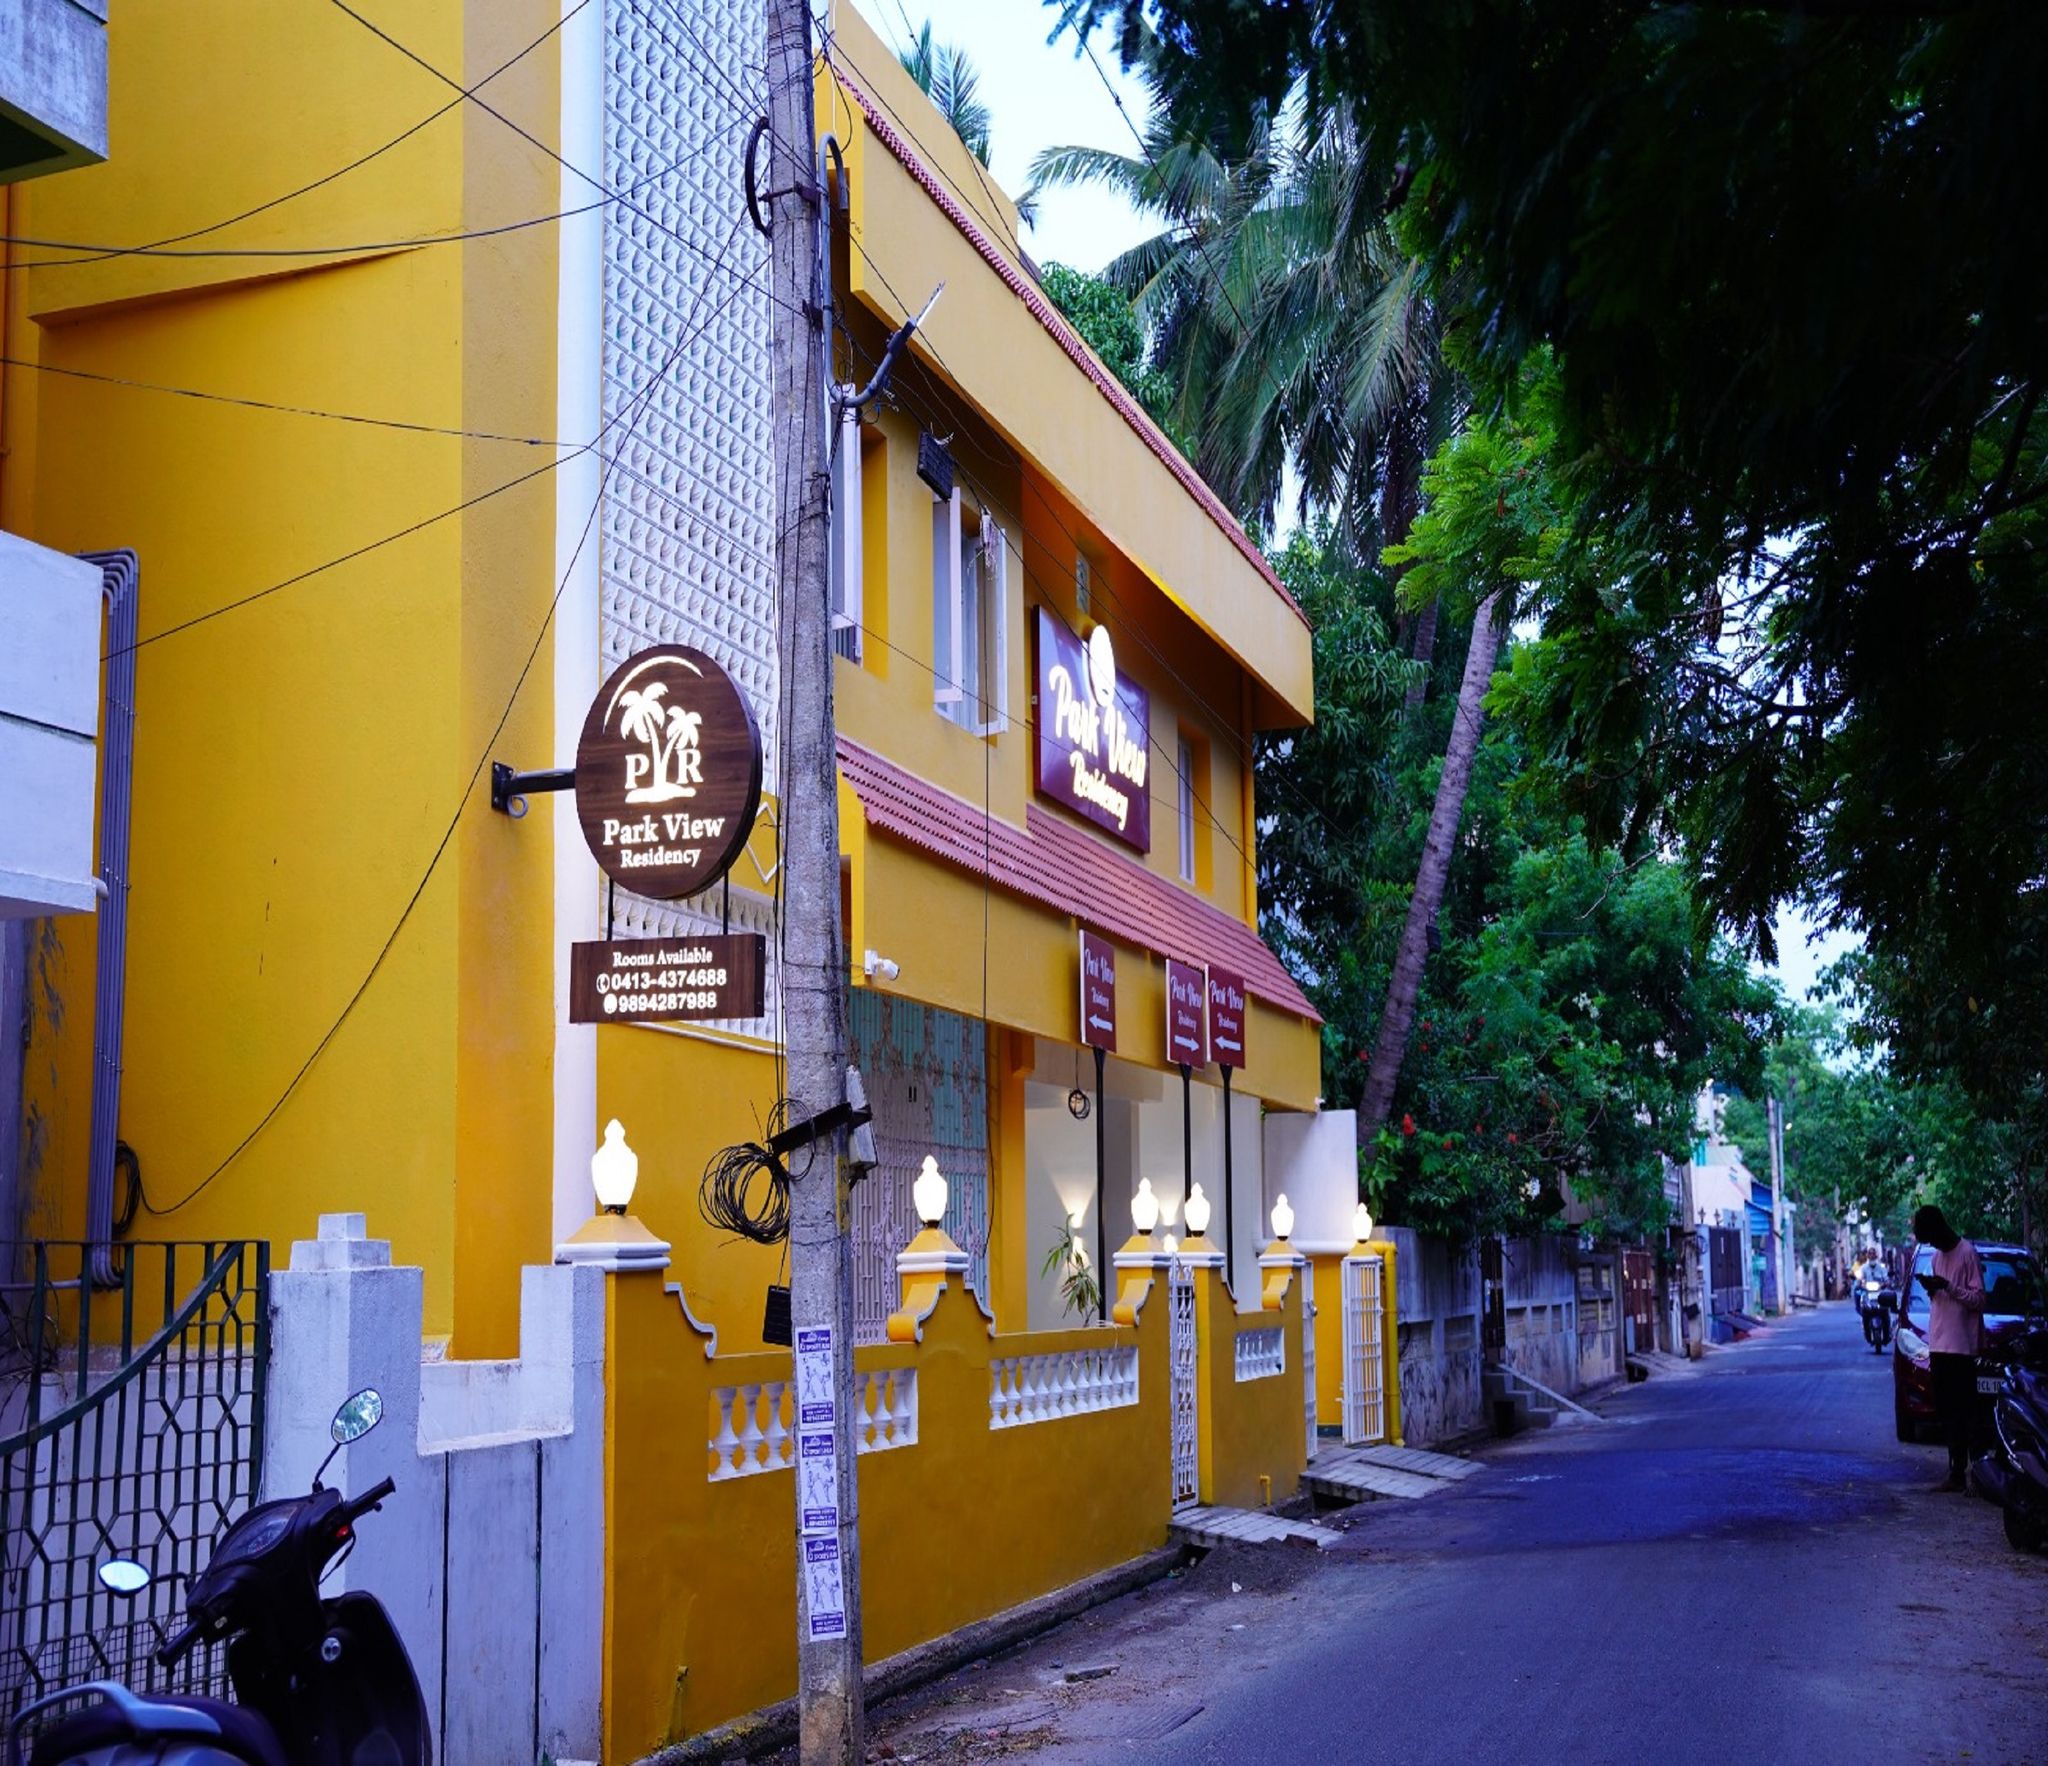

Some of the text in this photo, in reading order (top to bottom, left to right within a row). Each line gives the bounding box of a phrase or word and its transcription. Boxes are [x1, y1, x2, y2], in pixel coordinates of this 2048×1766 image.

[1049, 665, 1147, 788] Park View
[1069, 750, 1129, 832] Residency
[602, 812, 726, 846] Park View
[620, 846, 702, 869] Residency
[612, 946, 713, 968] Rooms Available
[611, 968, 728, 991] 0413-4374688
